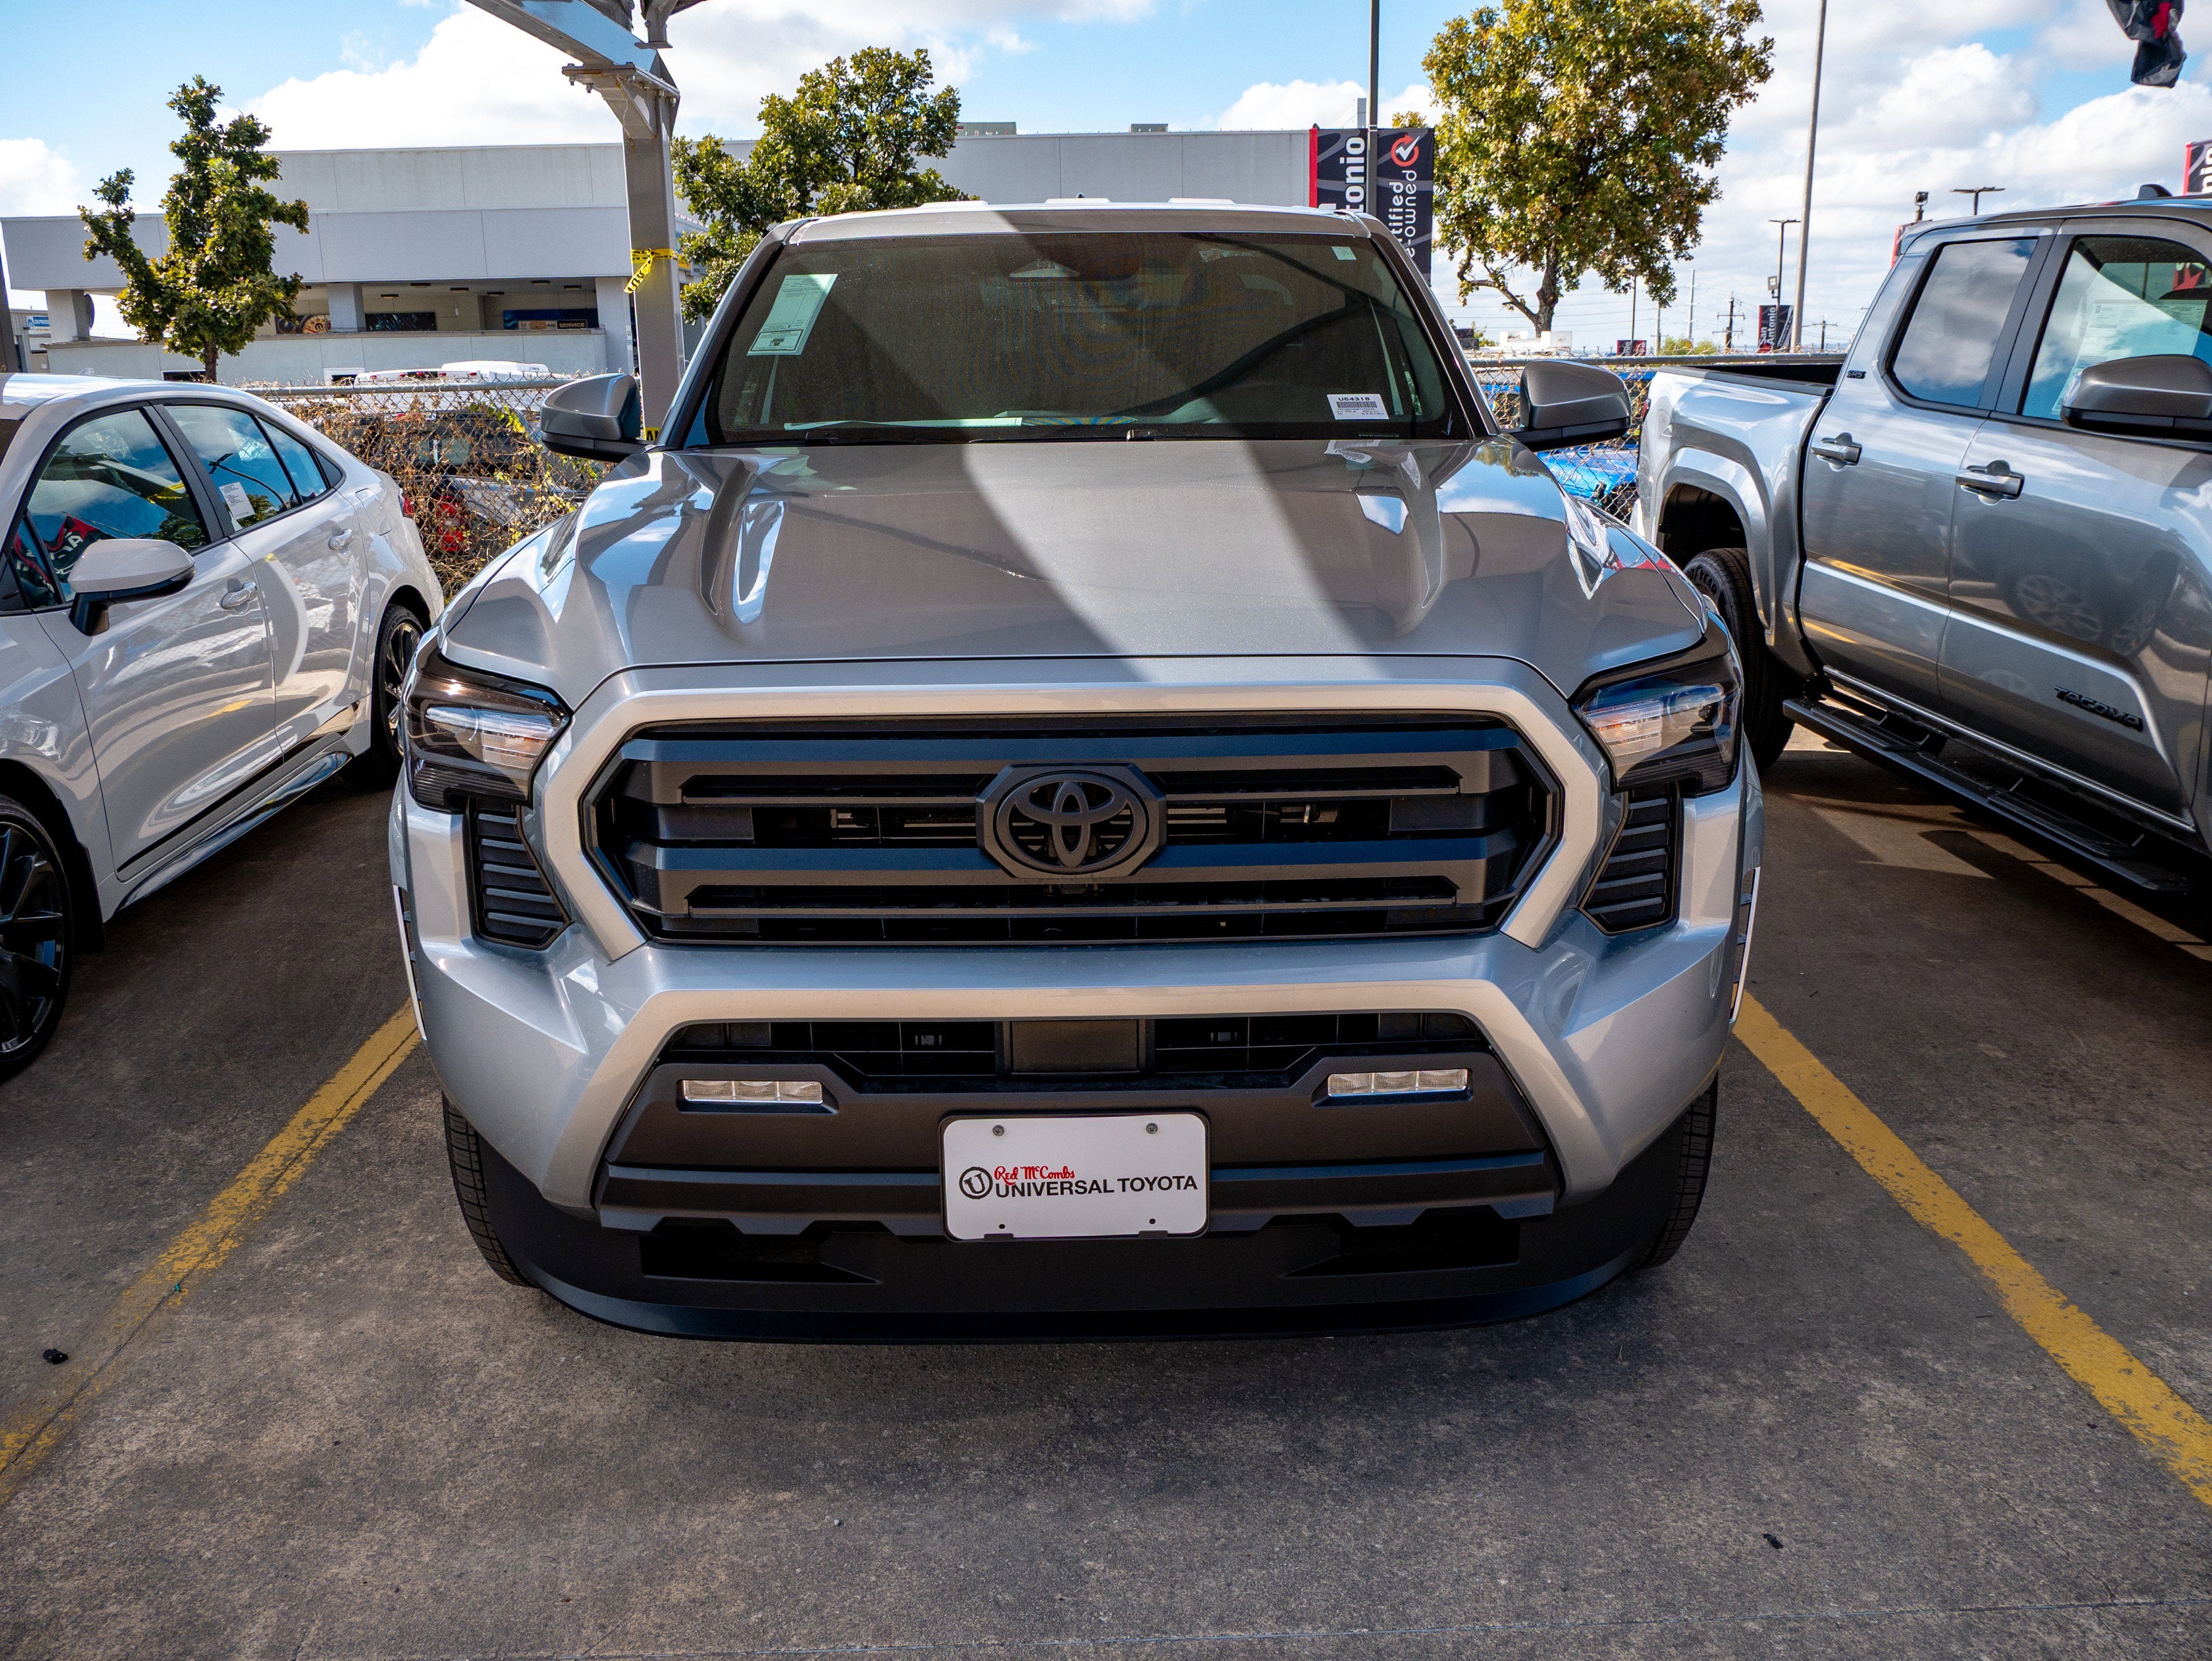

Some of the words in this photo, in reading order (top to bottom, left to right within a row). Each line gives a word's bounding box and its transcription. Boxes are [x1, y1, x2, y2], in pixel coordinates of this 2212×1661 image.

[1389, 182, 1404, 244] tified
[1759, 327, 1767, 345] San
[1766, 307, 1776, 345] Antonio
[2054, 684, 2143, 732] TACOMA
[994, 1166, 1019, 1186] Red
[1020, 1165, 1075, 1180] McCombs
[995, 1179, 1115, 1198] UNIVERSAL
[1117, 1175, 1199, 1194] TOYOTA
